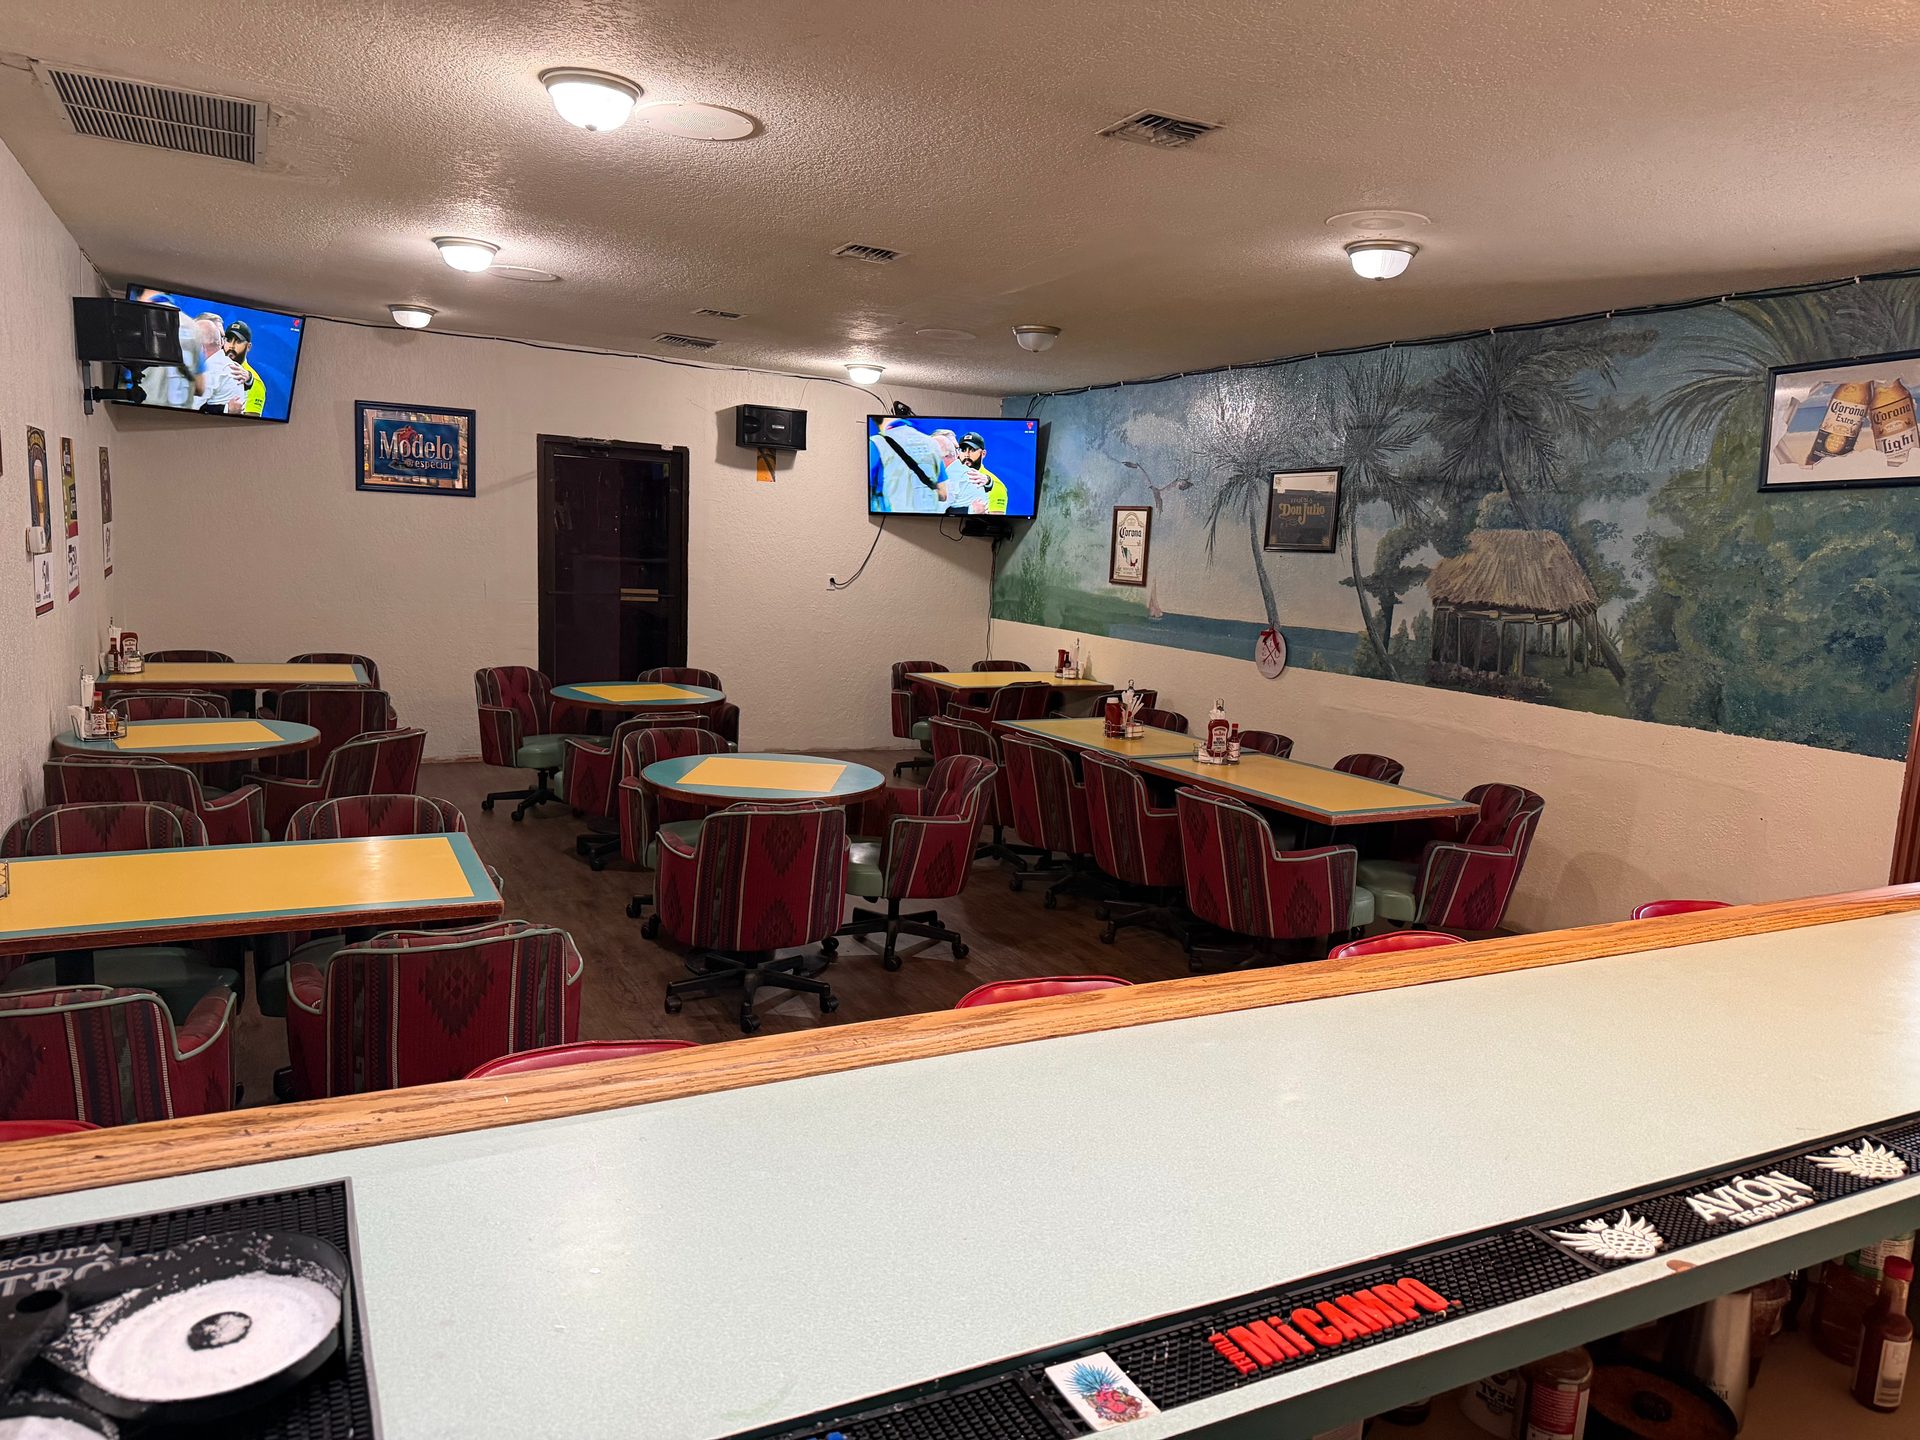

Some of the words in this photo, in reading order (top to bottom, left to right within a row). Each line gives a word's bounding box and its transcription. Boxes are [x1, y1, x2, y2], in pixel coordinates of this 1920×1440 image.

[1831, 401, 1865, 417] Corona
[1873, 404, 1911, 425] Corona
[379, 430, 454, 460] Modelo
[1881, 434, 1914, 454] Light
[415, 460, 452, 470] especial
[1279, 503, 1302, 517] Don
[1298, 502, 1325, 525] Julio
[1119, 526, 1142, 539] Corona
[1728, 1195, 1816, 1226] TEQUILA
[0, 1255, 156, 1297] TRÓ
[1227, 1315, 1316, 1368] Mi
[1208, 1332, 1258, 1375] TEQUILA
